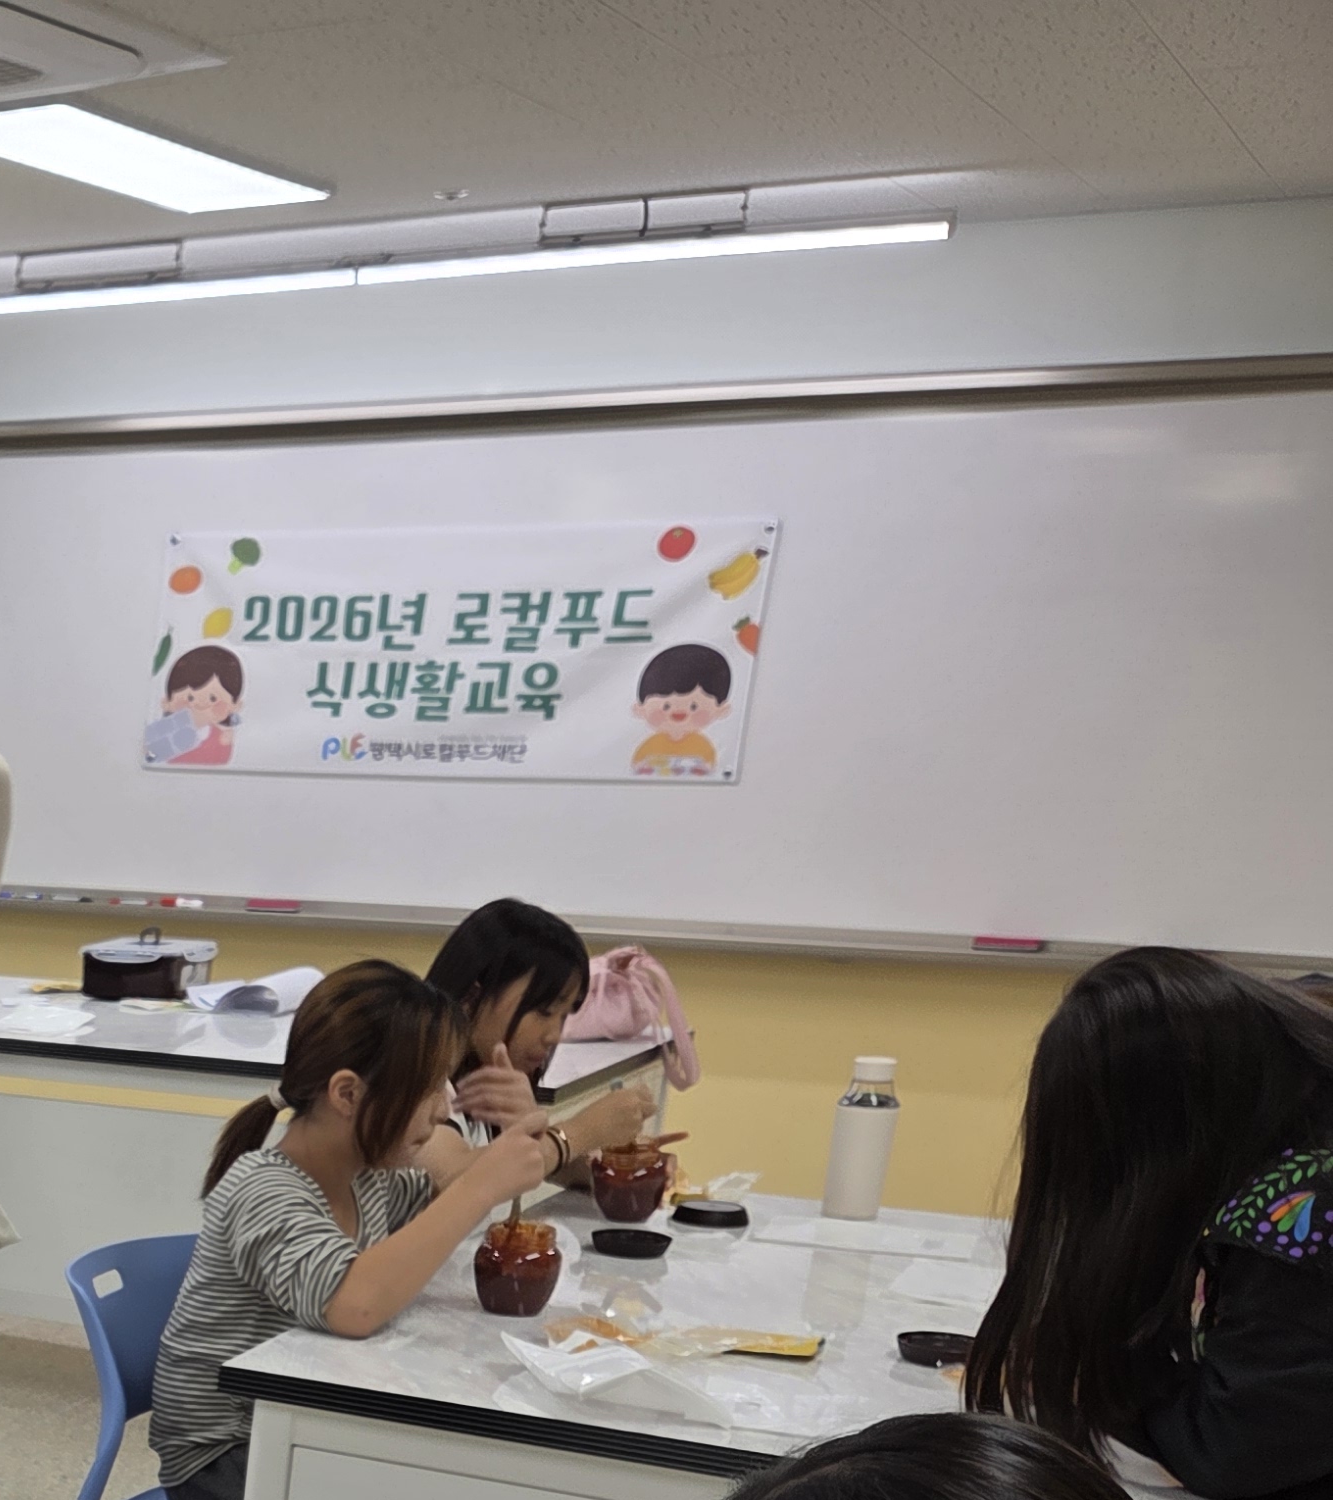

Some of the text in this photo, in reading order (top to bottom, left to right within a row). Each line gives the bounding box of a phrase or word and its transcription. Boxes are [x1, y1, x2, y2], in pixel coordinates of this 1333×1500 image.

[242, 587, 655, 655] 2026년 로컬푸드
[306, 660, 563, 723] 식생활교육
